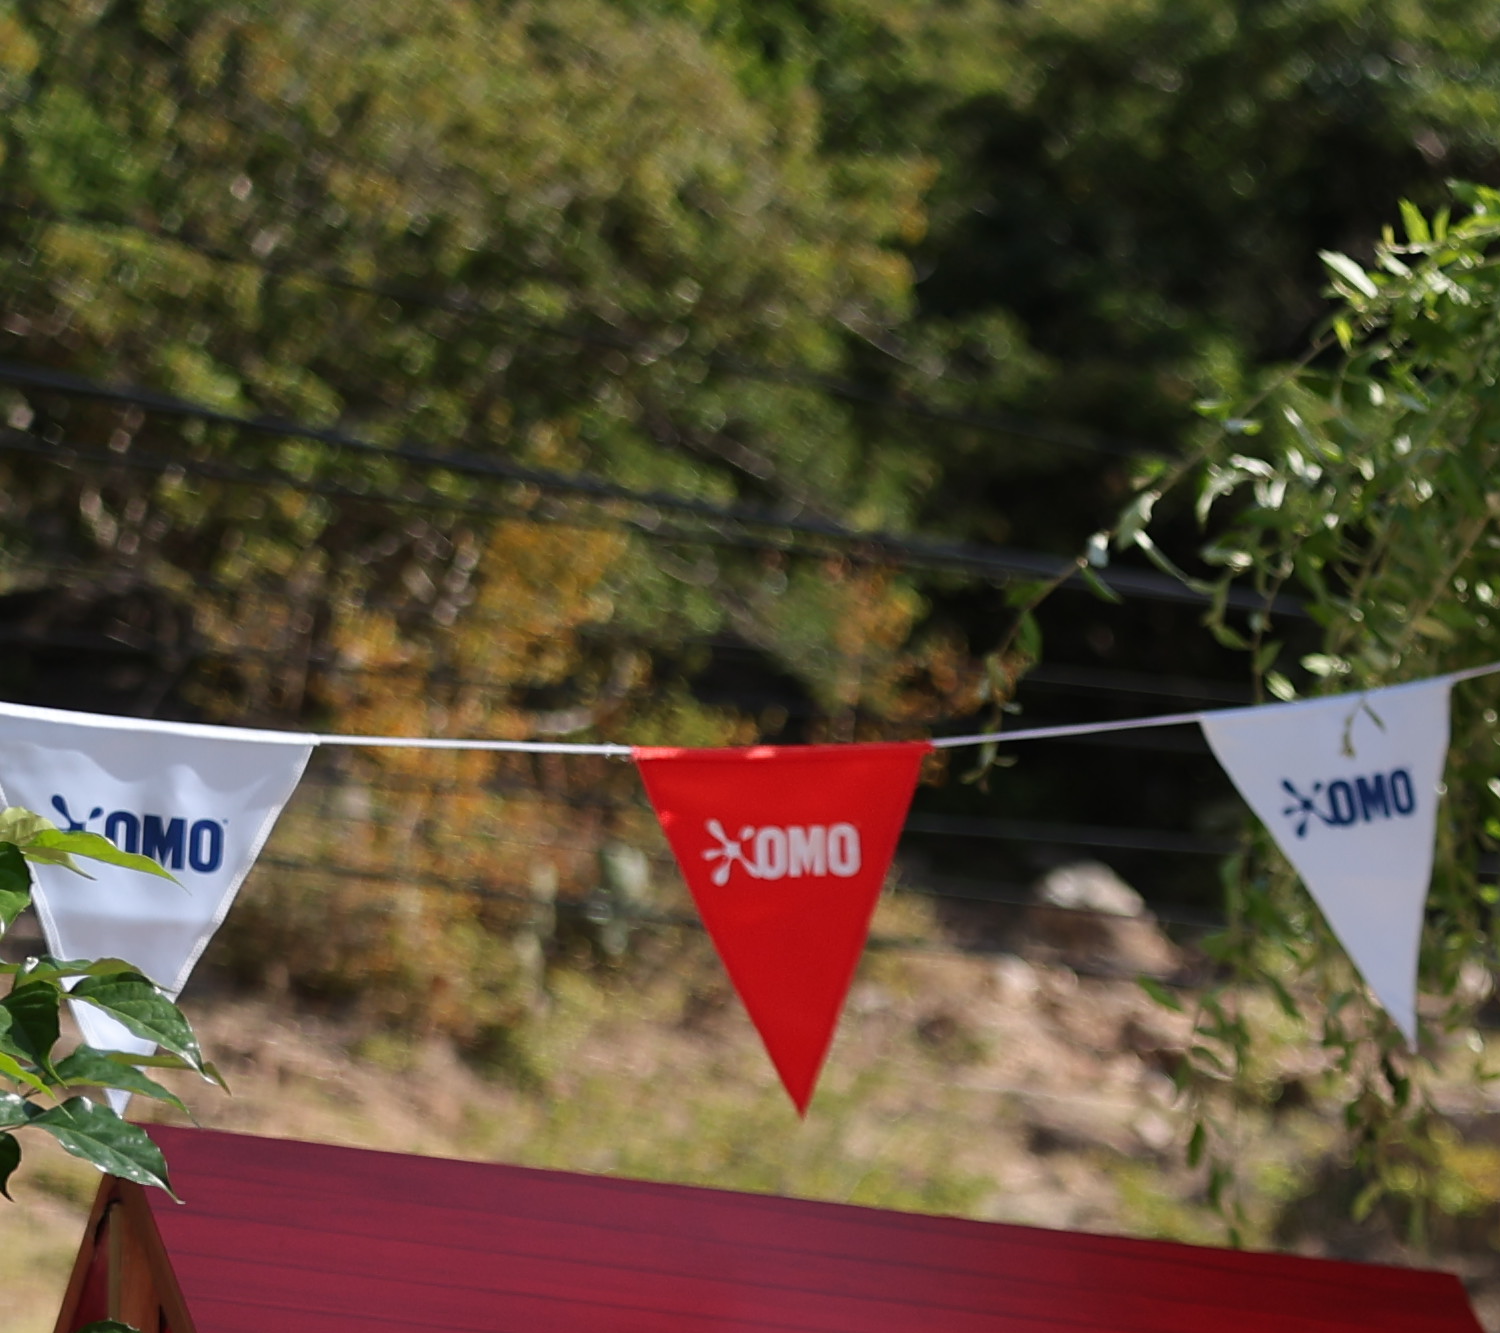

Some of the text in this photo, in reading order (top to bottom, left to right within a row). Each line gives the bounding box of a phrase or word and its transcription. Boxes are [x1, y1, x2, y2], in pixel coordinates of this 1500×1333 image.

[1326, 769, 1416, 826] OMO
[105, 810, 224, 873] OMO
[755, 822, 861, 880] OMO
